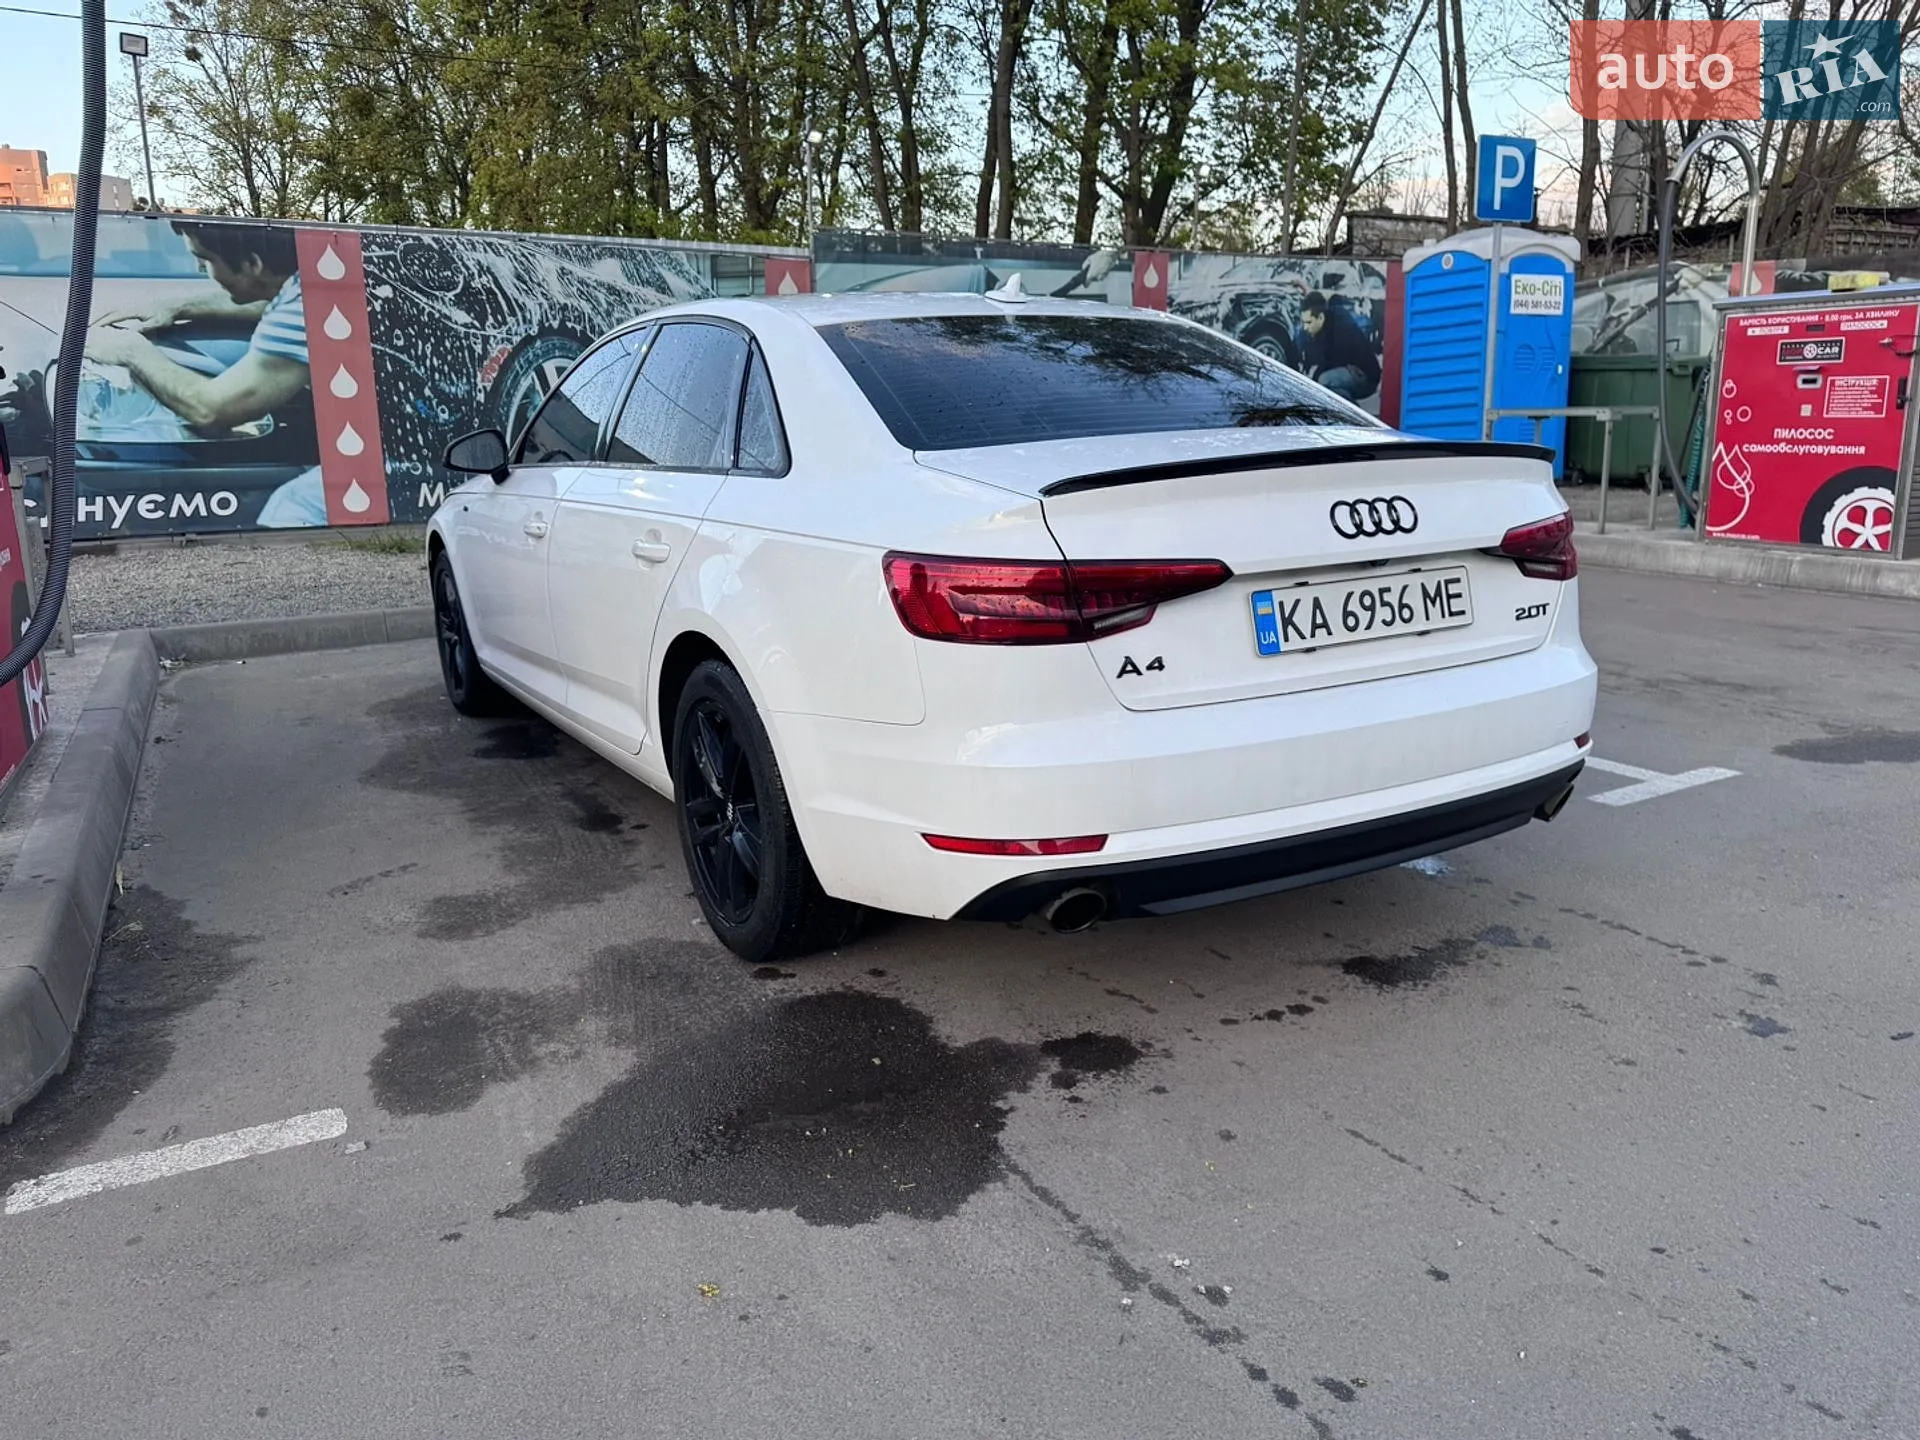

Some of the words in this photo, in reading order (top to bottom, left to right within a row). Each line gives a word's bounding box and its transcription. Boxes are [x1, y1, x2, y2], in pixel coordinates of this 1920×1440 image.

[1494, 145, 1525, 210] P
[1855, 311, 1864, 319] ЗА
[1817, 346, 1840, 355] CAR
[1773, 428, 1835, 440] ПИЛОСОС
[1742, 442, 1867, 456] самообслуговування
[1278, 596, 1334, 643] KA
[1342, 584, 1415, 633] 6956
[1421, 577, 1466, 622] ME
[1260, 631, 1278, 645] UA
[1116, 655, 1166, 679] A4
